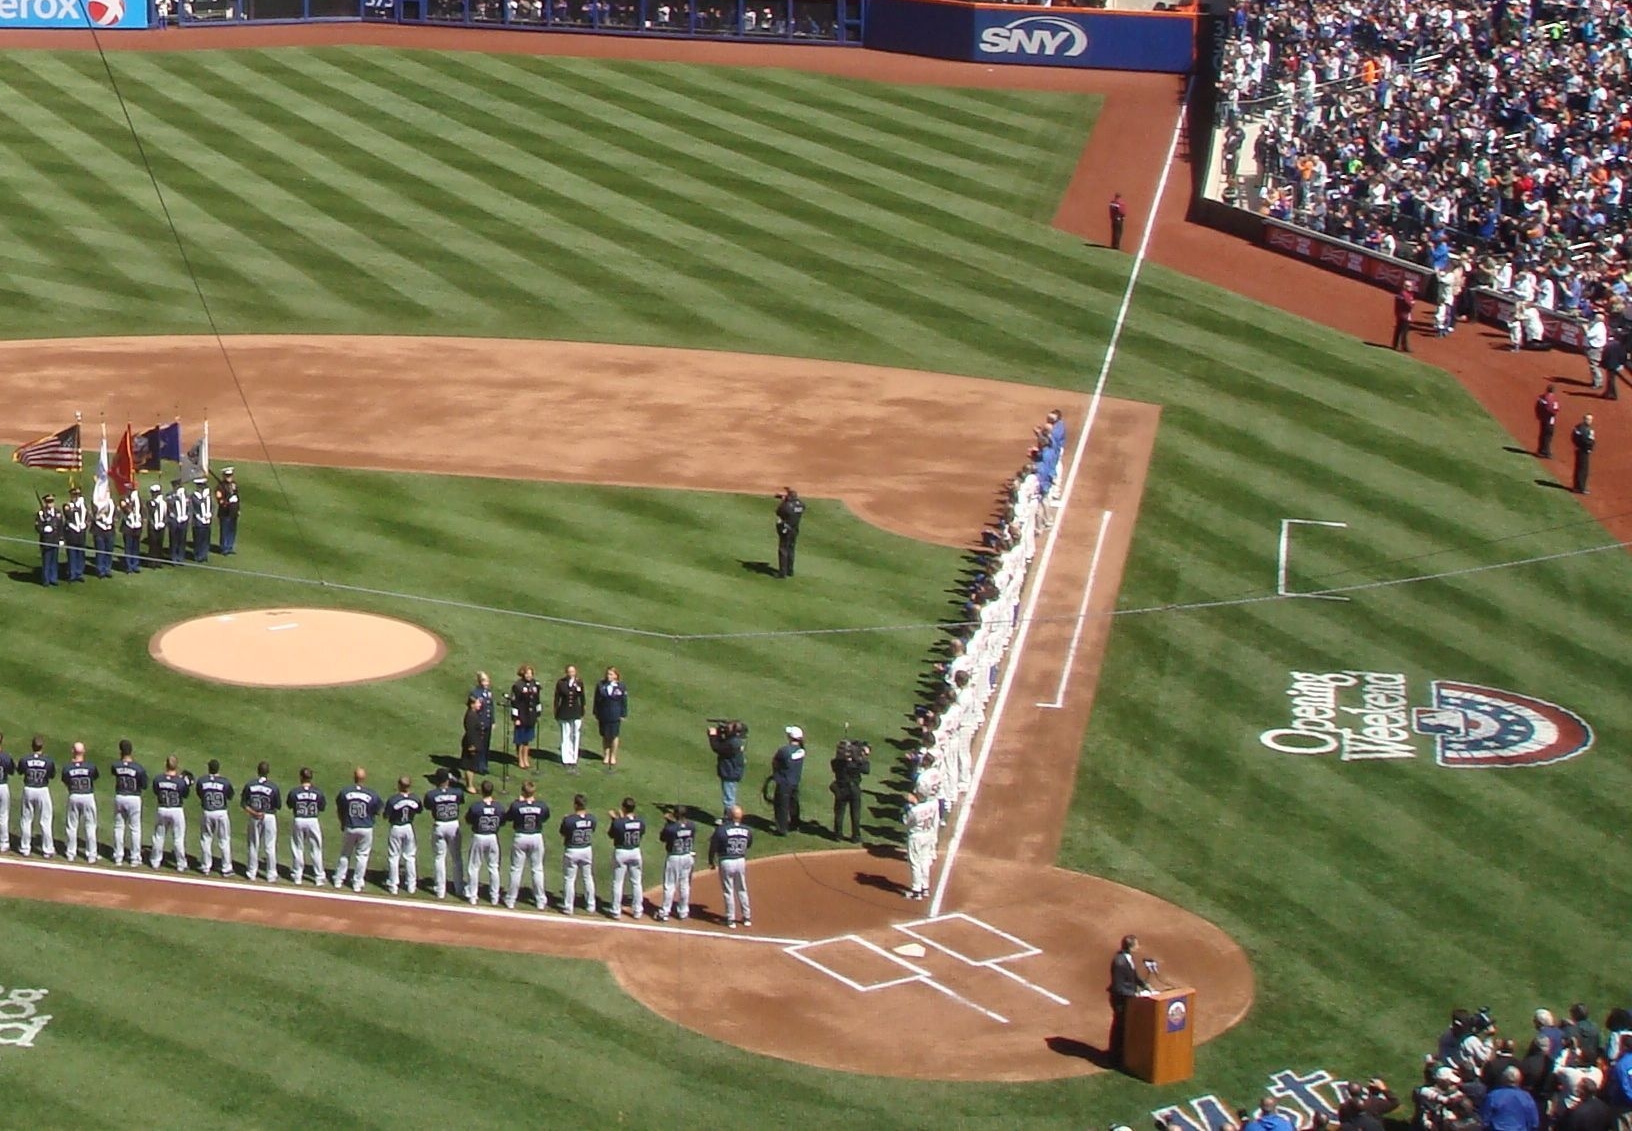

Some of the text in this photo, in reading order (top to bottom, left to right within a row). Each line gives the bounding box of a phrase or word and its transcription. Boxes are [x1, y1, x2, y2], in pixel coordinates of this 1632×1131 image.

[979, 26, 1070, 56] SNY
[1260, 671, 1357, 755] Opening
[1341, 671, 1417, 761] Weekend
